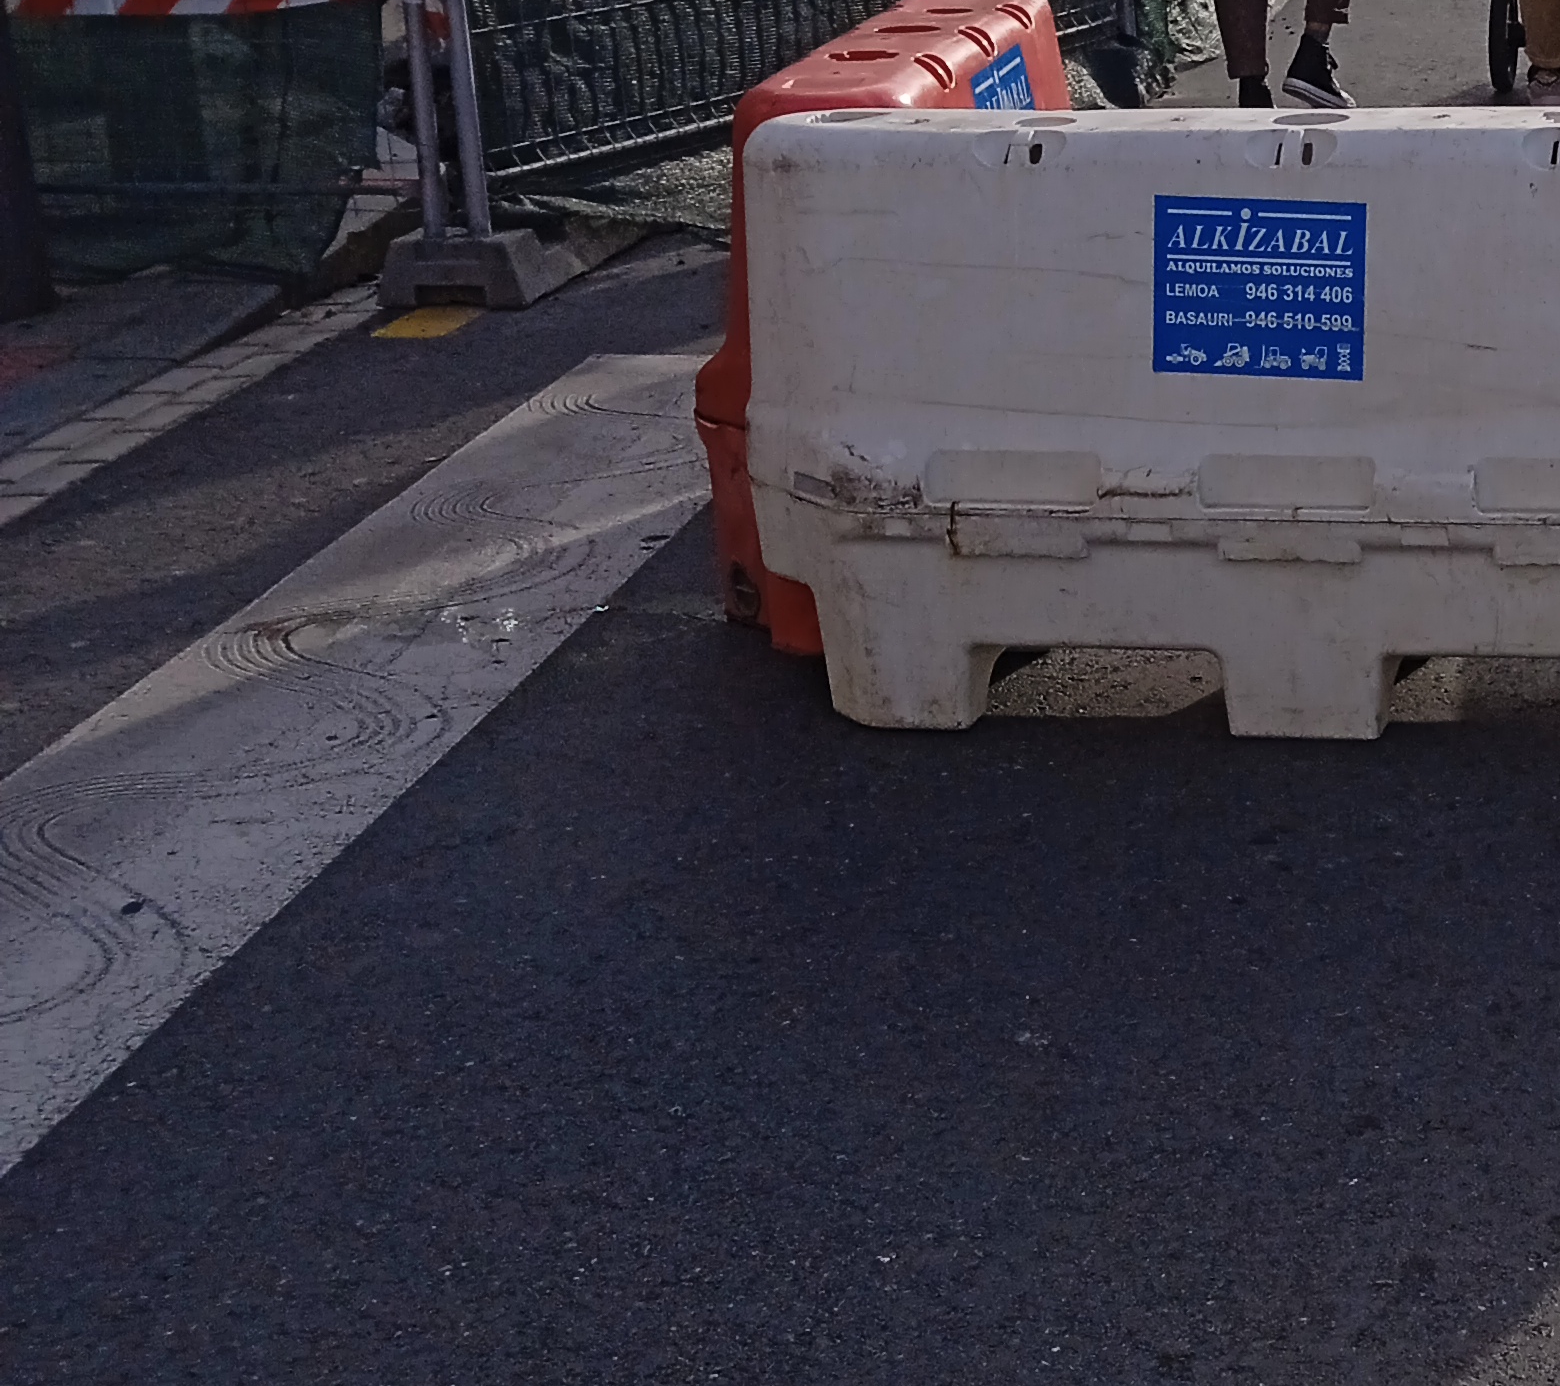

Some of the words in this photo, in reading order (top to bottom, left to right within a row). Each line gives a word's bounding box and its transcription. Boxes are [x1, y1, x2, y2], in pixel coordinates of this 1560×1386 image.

[1166, 261, 1260, 275] ALQUILAMOS
[1263, 265, 1354, 278] SOLUCIONES
[1166, 283, 1219, 298] LEMOA
[1245, 283, 1277, 300] 946
[1283, 284, 1315, 302] 314
[1320, 286, 1353, 303] 406
[1165, 311, 1233, 327] BASAURI
[1245, 311, 1277, 328] 946
[1283, 313, 1315, 330] 510
[1320, 314, 1352, 331] 599
